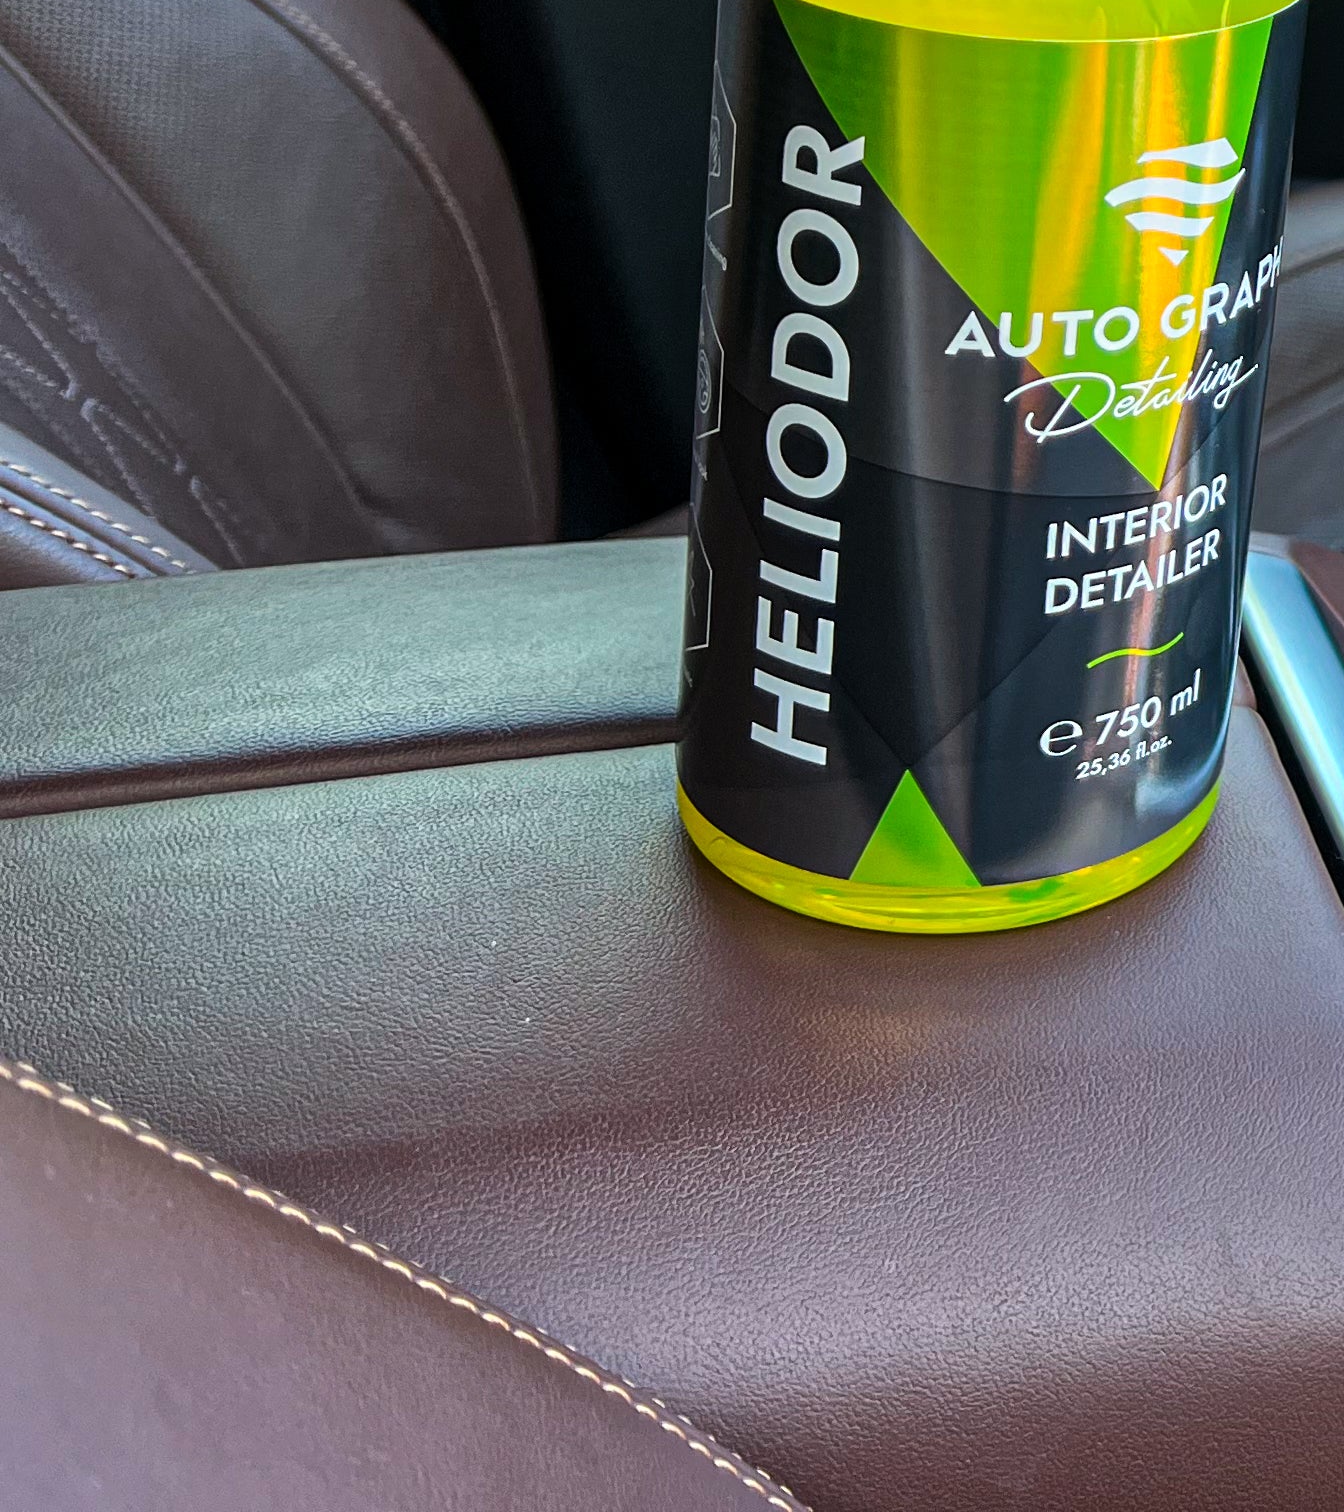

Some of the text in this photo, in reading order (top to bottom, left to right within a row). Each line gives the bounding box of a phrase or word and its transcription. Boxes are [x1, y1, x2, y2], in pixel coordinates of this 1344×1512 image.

[944, 236, 1284, 358] AUTO GRAPH
[1003, 348, 1260, 444] Detailing
[750, 124, 866, 767] HELIODOR
[1045, 473, 1228, 560] INTERIOR
[1044, 528, 1221, 615] DETAILER
[1095, 696, 1163, 746] 750
[1169, 668, 1202, 716] ml
[1075, 752, 1132, 780] 25,36
